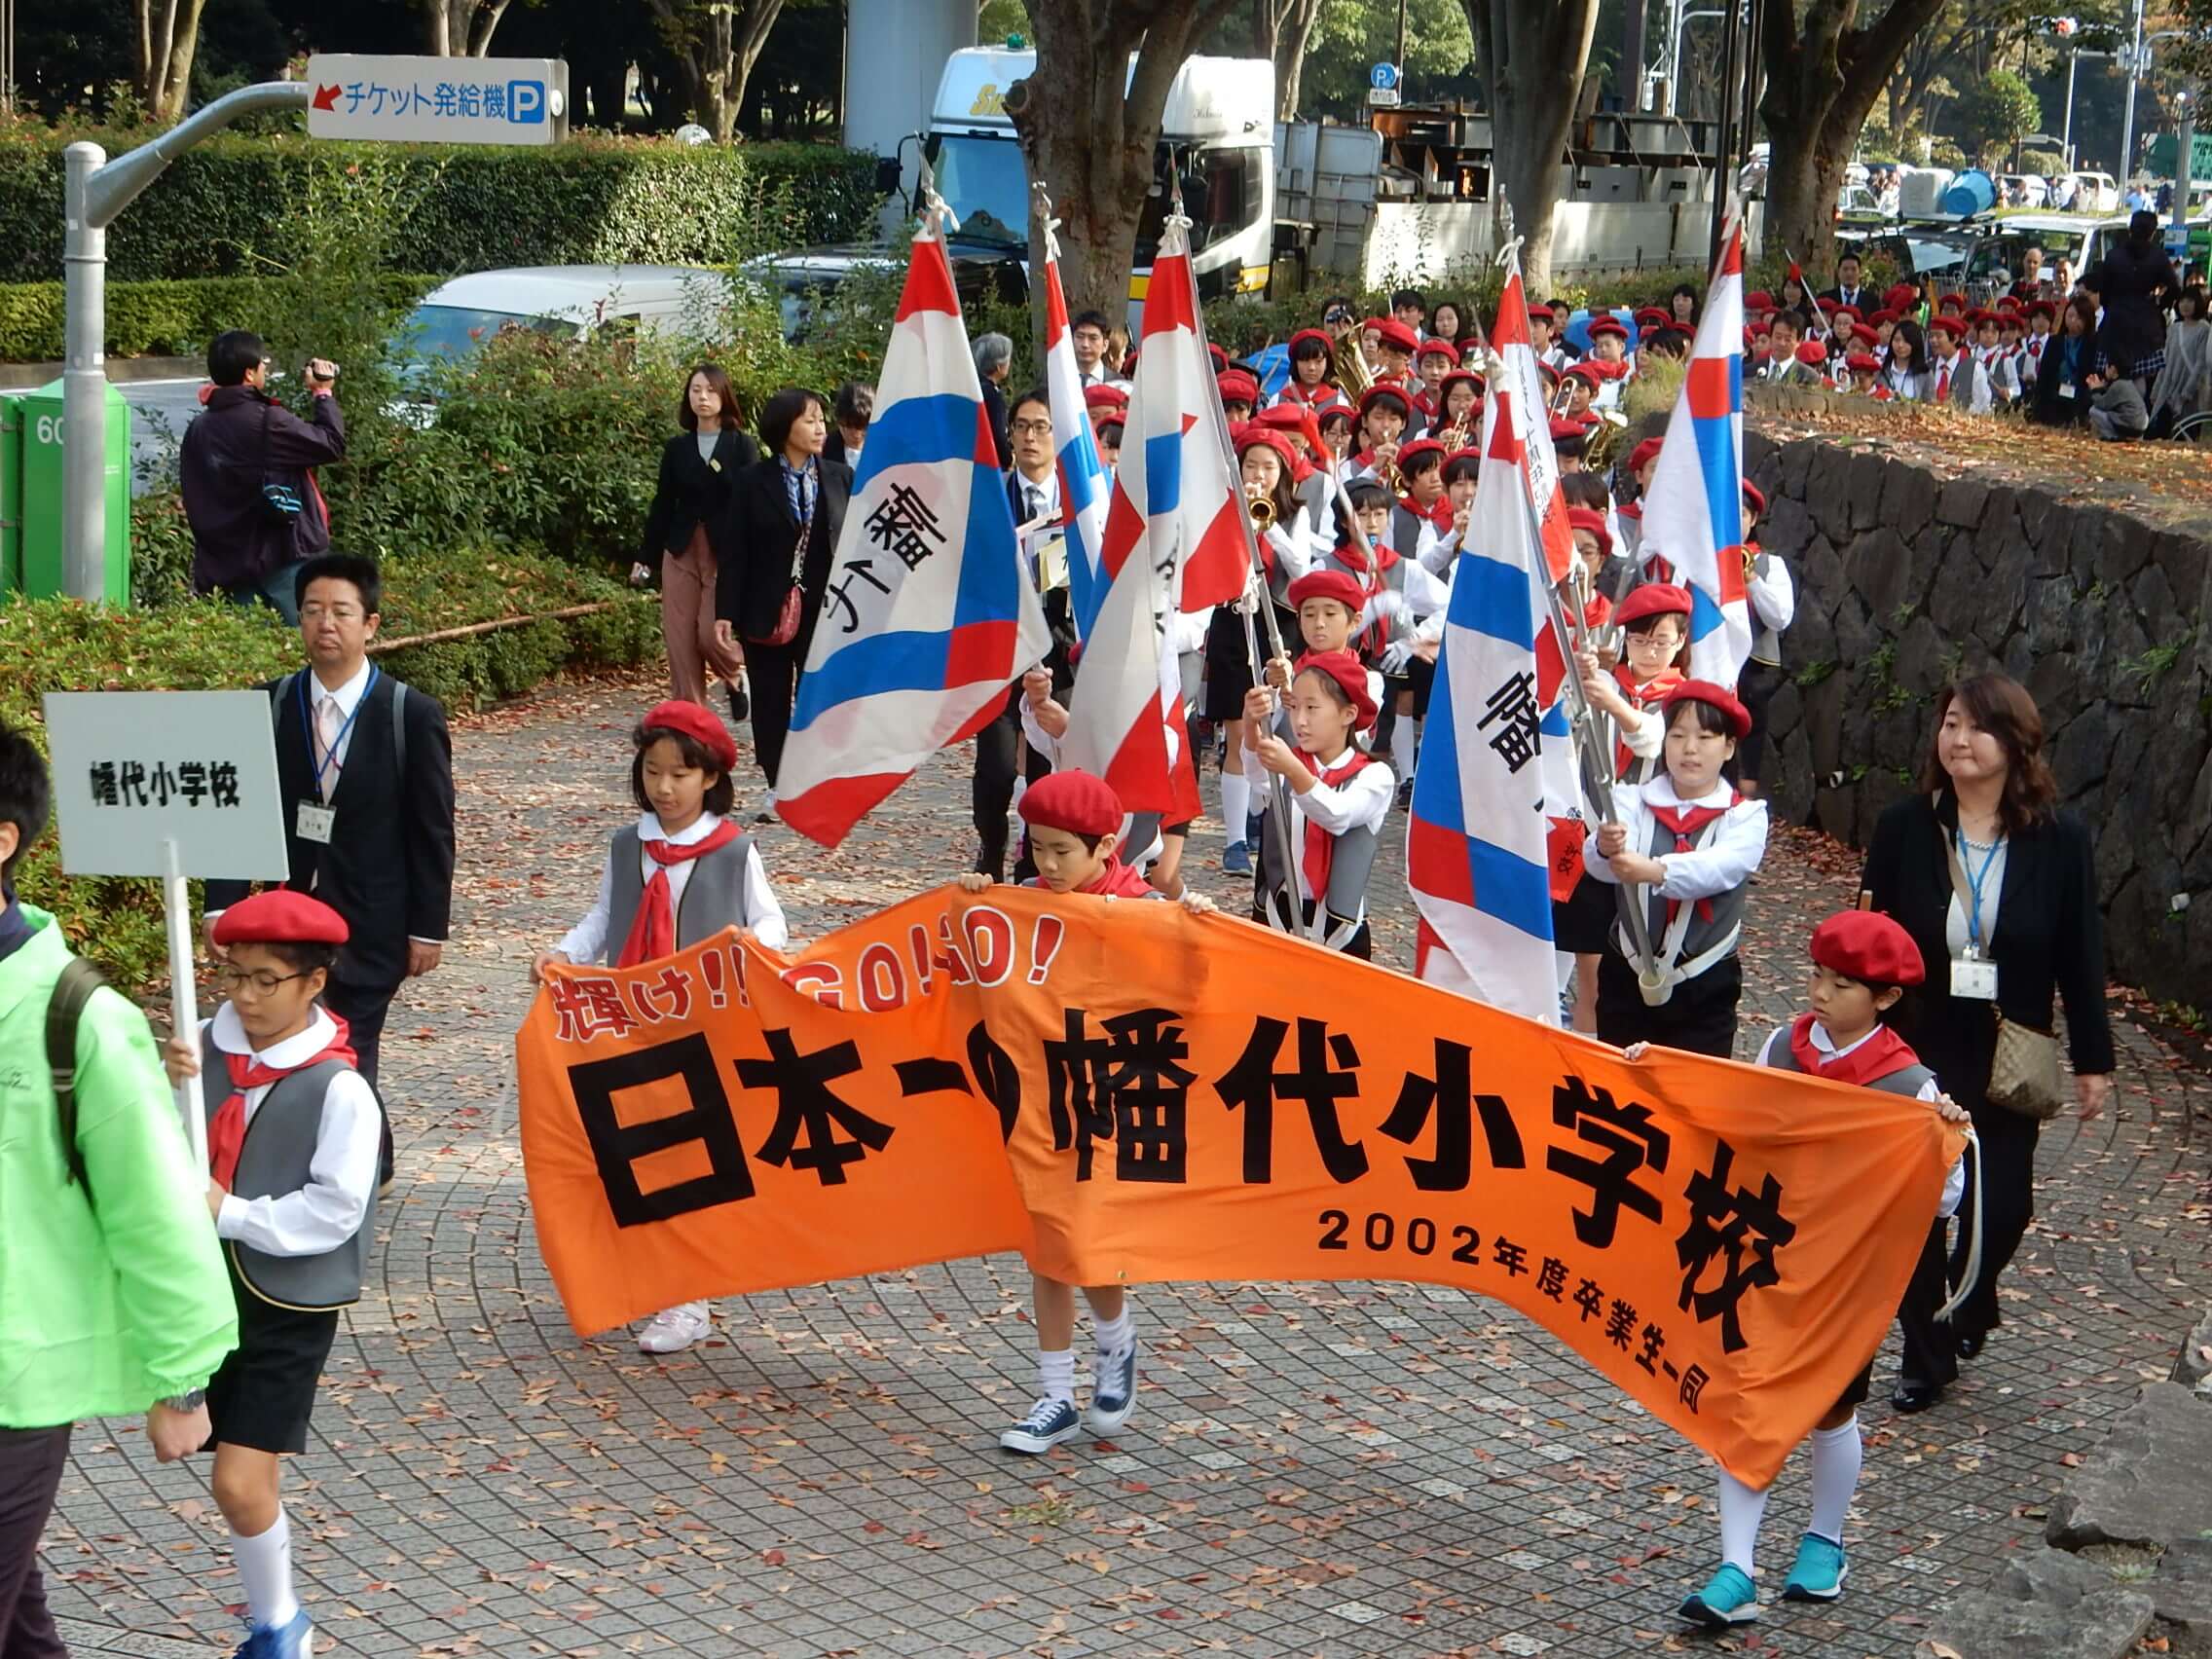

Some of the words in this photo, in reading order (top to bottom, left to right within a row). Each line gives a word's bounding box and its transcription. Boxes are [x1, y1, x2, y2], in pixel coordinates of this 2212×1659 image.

[346, 82, 505, 119] チケット発給機
[512, 84, 540, 121] P
[90, 760, 240, 807] 幡代小学校
[779, 905, 1064, 1013] GO!O!
[568, 1008, 1796, 1354] 日本一の幡代小学校
[1318, 1209, 1711, 1416] 2002年度卒業生一同
